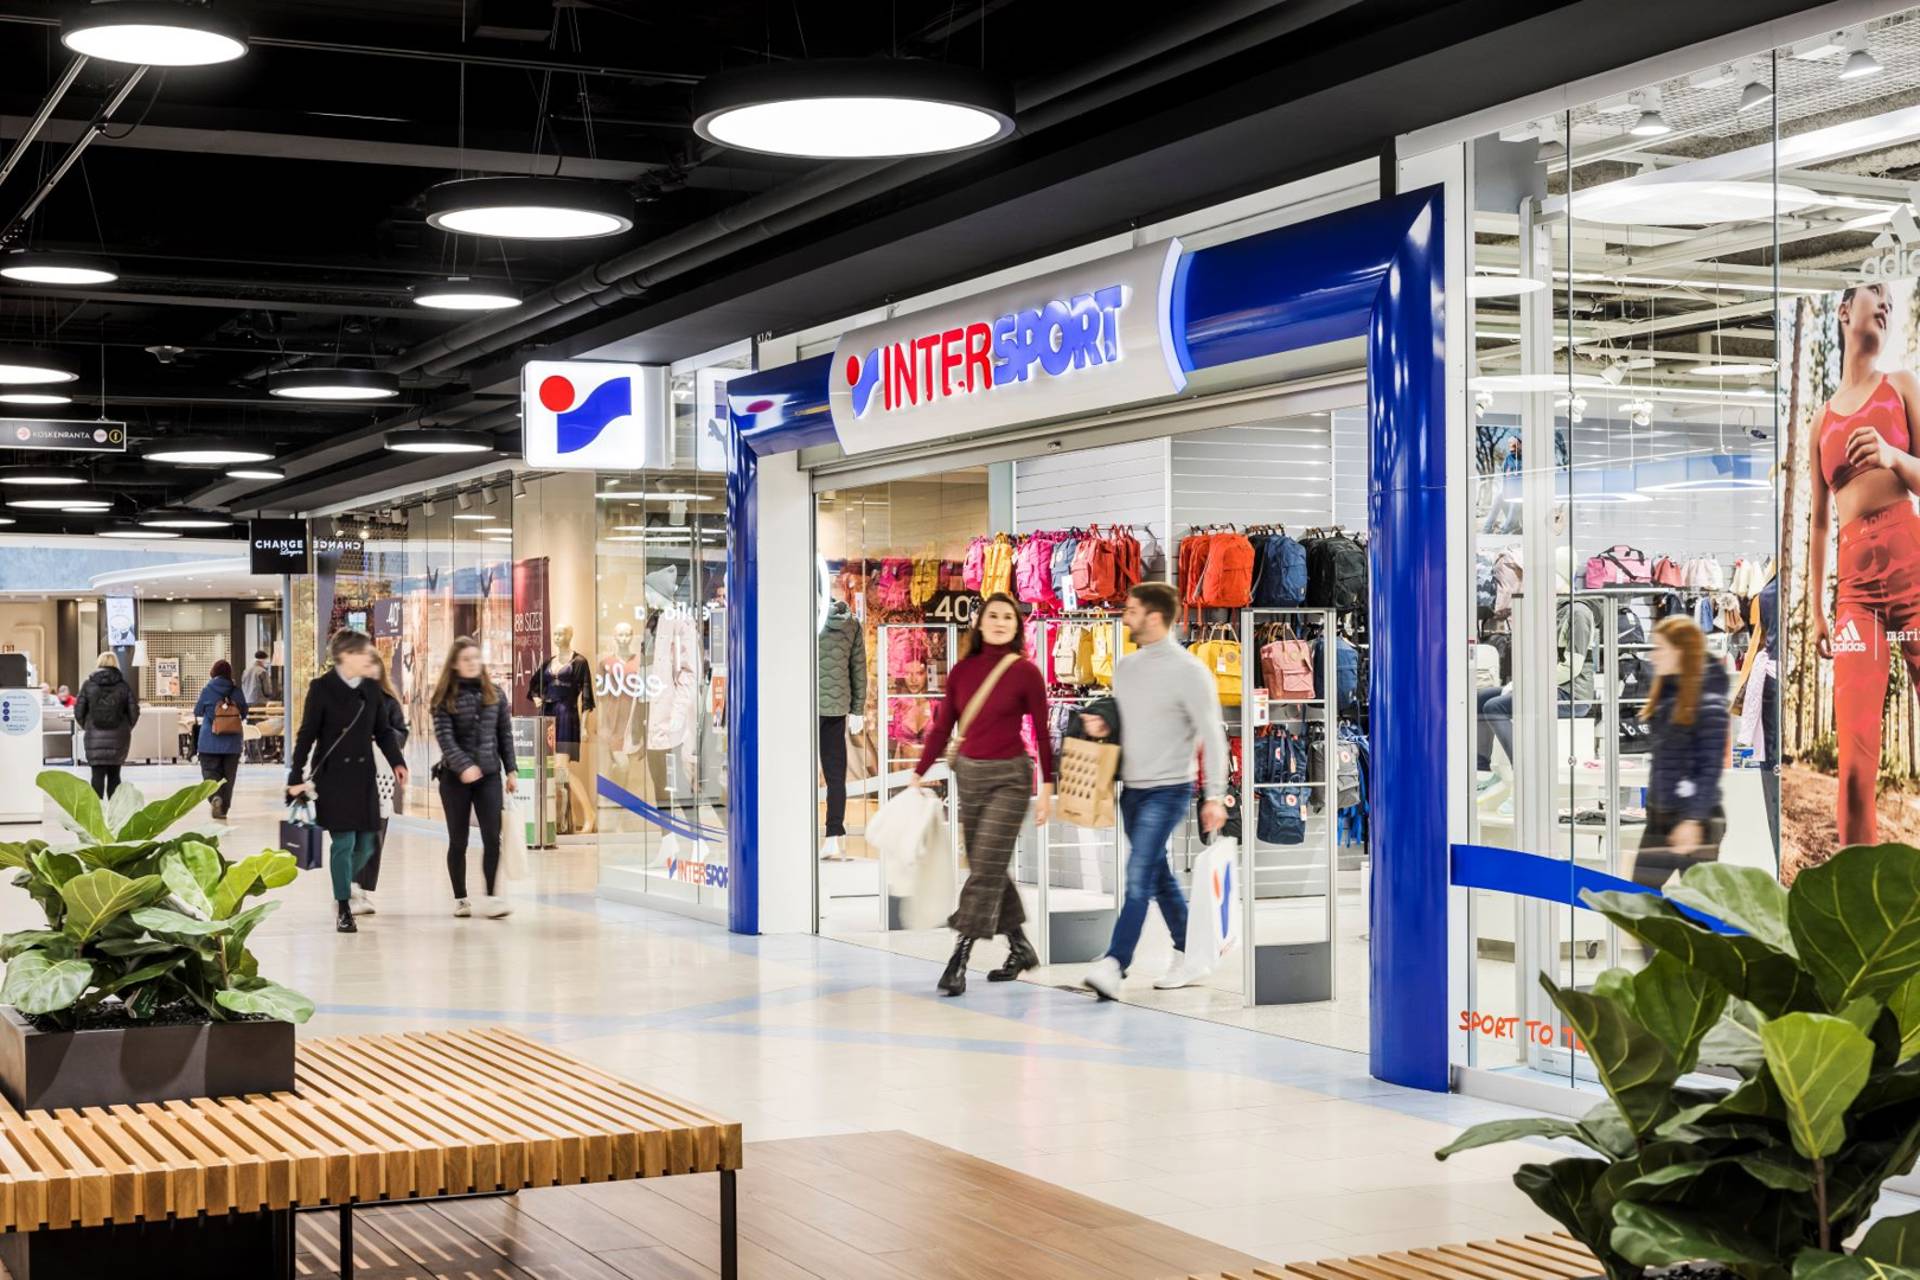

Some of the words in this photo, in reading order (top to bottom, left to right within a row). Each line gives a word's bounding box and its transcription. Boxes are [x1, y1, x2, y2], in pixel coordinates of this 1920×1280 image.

[884, 285, 1122, 411] INTERSPORT
[255, 539, 304, 549] CHANGE
[1830, 640, 1867, 653] adidas
[1458, 1010, 1520, 1039] SPORT
[1525, 1020, 1554, 1046] TO
